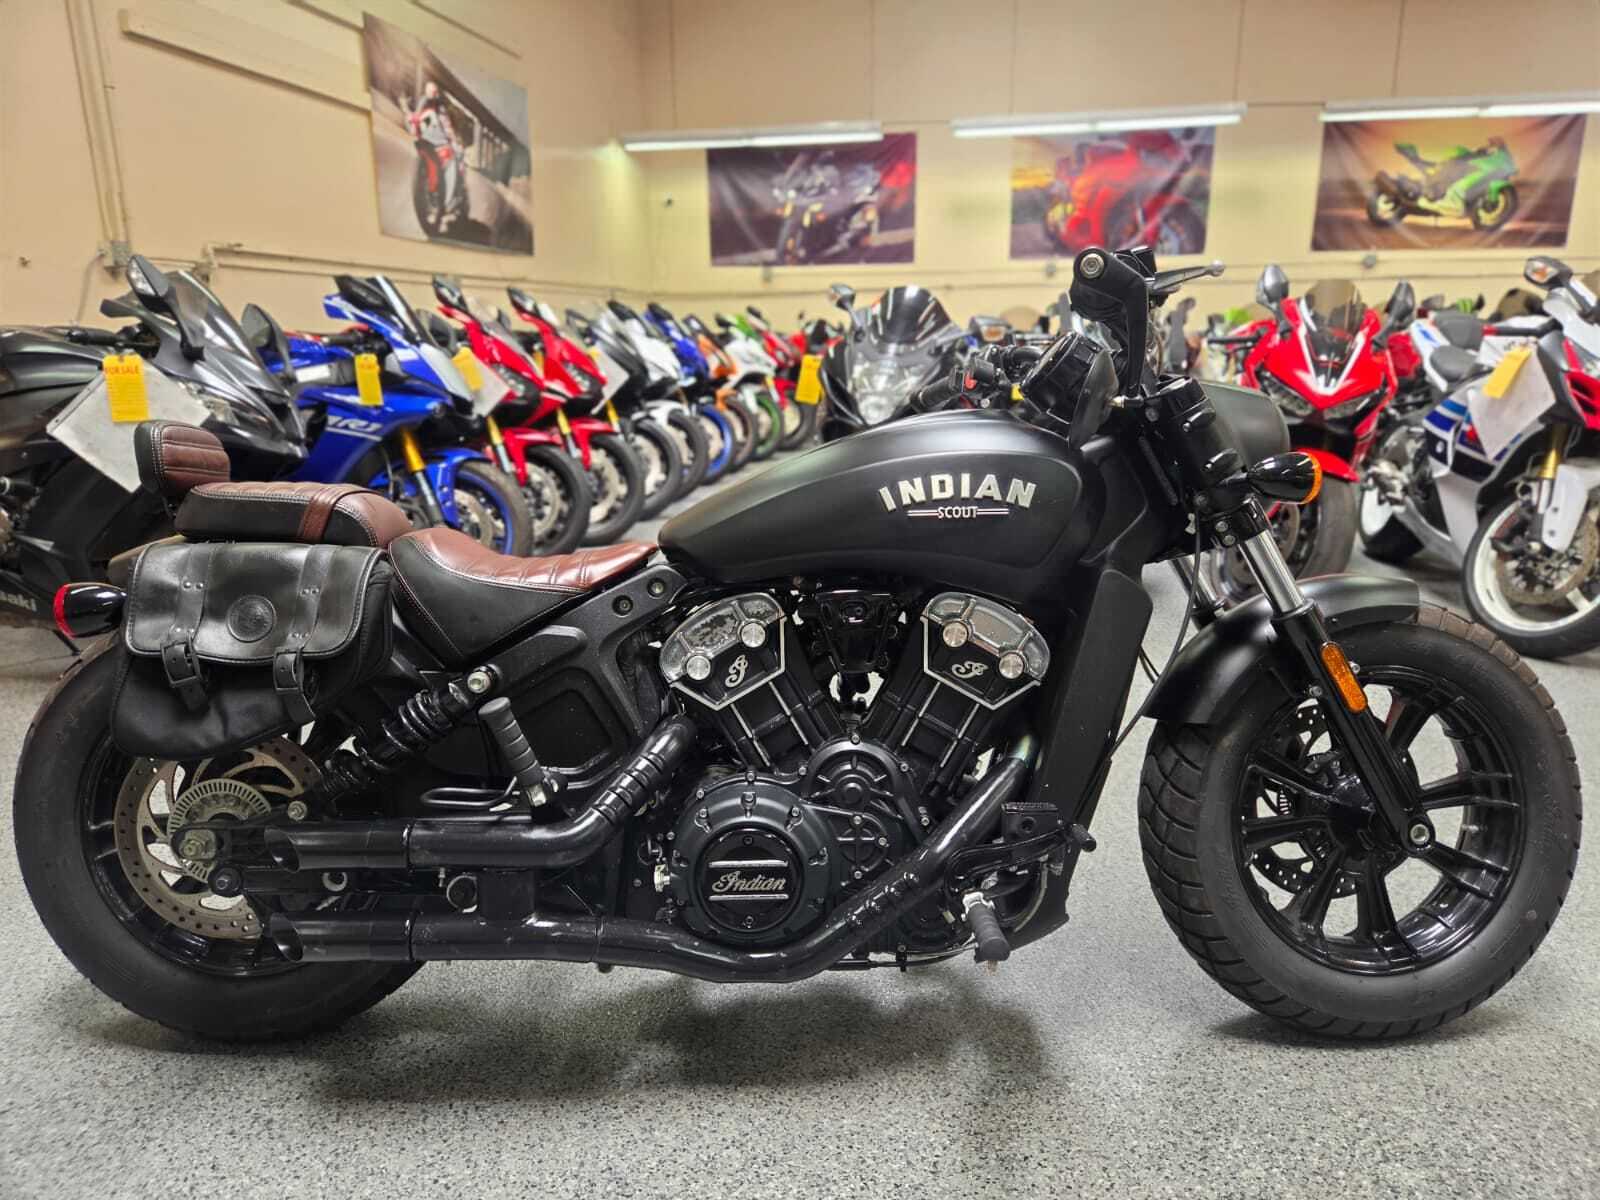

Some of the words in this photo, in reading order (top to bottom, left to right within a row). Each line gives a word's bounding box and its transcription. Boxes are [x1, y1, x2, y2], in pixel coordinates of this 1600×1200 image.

[121, 365, 139, 374] SALE
[879, 472, 1037, 512] INDIAN
[937, 506, 978, 519] SCOUT
[712, 870, 786, 893] Indian
